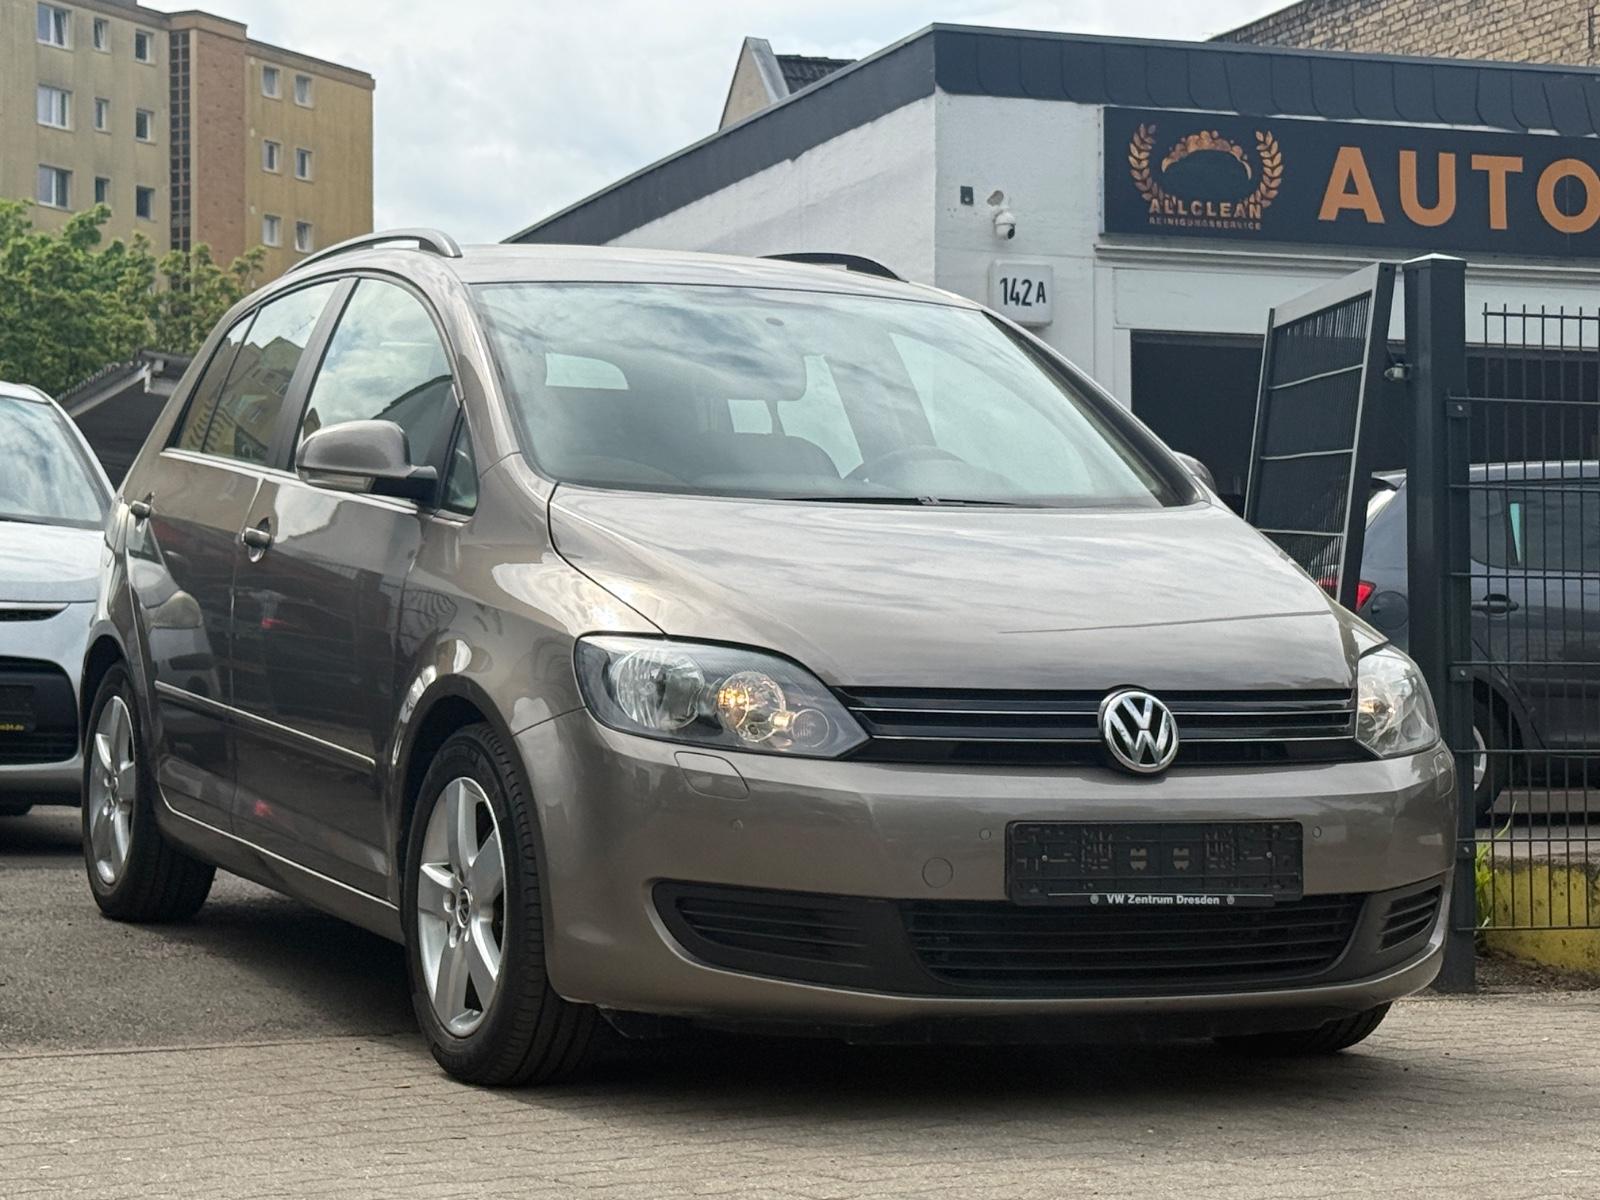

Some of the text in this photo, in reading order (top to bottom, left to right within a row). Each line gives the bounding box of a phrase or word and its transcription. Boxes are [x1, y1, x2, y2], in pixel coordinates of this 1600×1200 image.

[1149, 198, 1261, 219] ALLCLEAN
[1318, 146, 1600, 233] AUTO
[1104, 691, 1175, 768] VW
[1106, 893, 1124, 904] VW
[1127, 893, 1173, 905] Zentrum
[1176, 894, 1220, 905] Dresden
